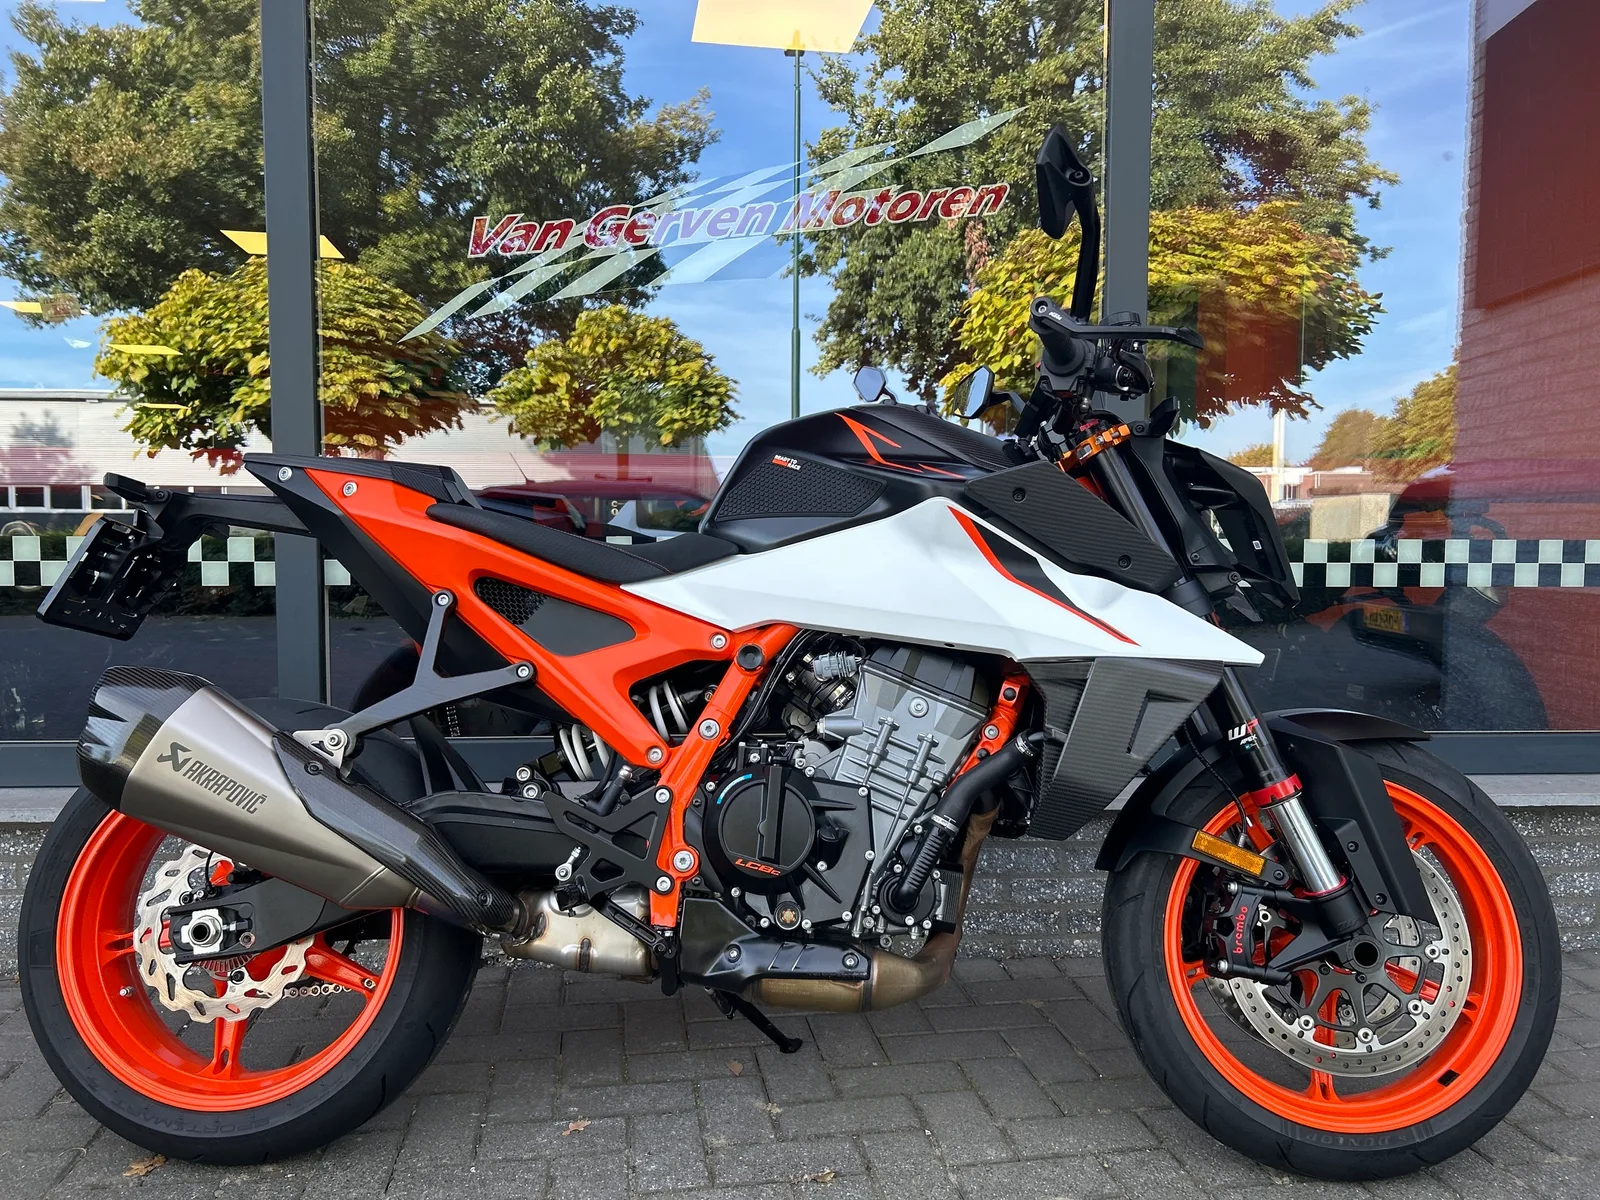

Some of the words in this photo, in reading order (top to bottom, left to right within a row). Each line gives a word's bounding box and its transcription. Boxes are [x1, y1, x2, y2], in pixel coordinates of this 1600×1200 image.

[466, 212, 576, 259] Van
[582, 200, 777, 250] Gerven
[772, 182, 1011, 236] Motoren
[774, 454, 791, 463] READY
[787, 462, 801, 471] RACE
[1233, 906, 1248, 954] brembo
